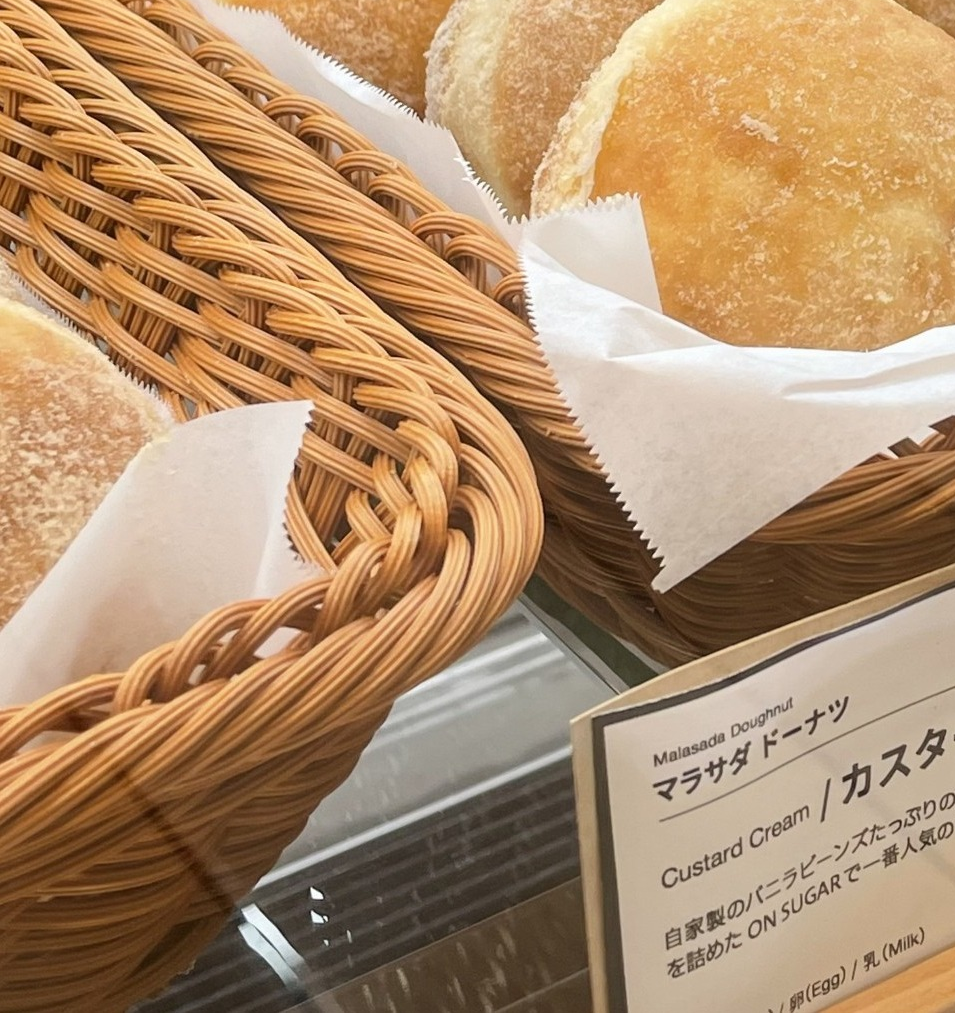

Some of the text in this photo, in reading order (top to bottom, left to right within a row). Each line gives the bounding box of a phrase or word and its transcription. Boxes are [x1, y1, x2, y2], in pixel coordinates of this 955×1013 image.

[652, 695, 850, 801] マラサダ ドーナツ
[653, 696, 794, 767] Malasada Doughnut
[661, 837, 743, 889] Custard
[749, 805, 810, 849] Cream
[747, 910, 777, 940] ON
[781, 873, 842, 923] SUGAR
